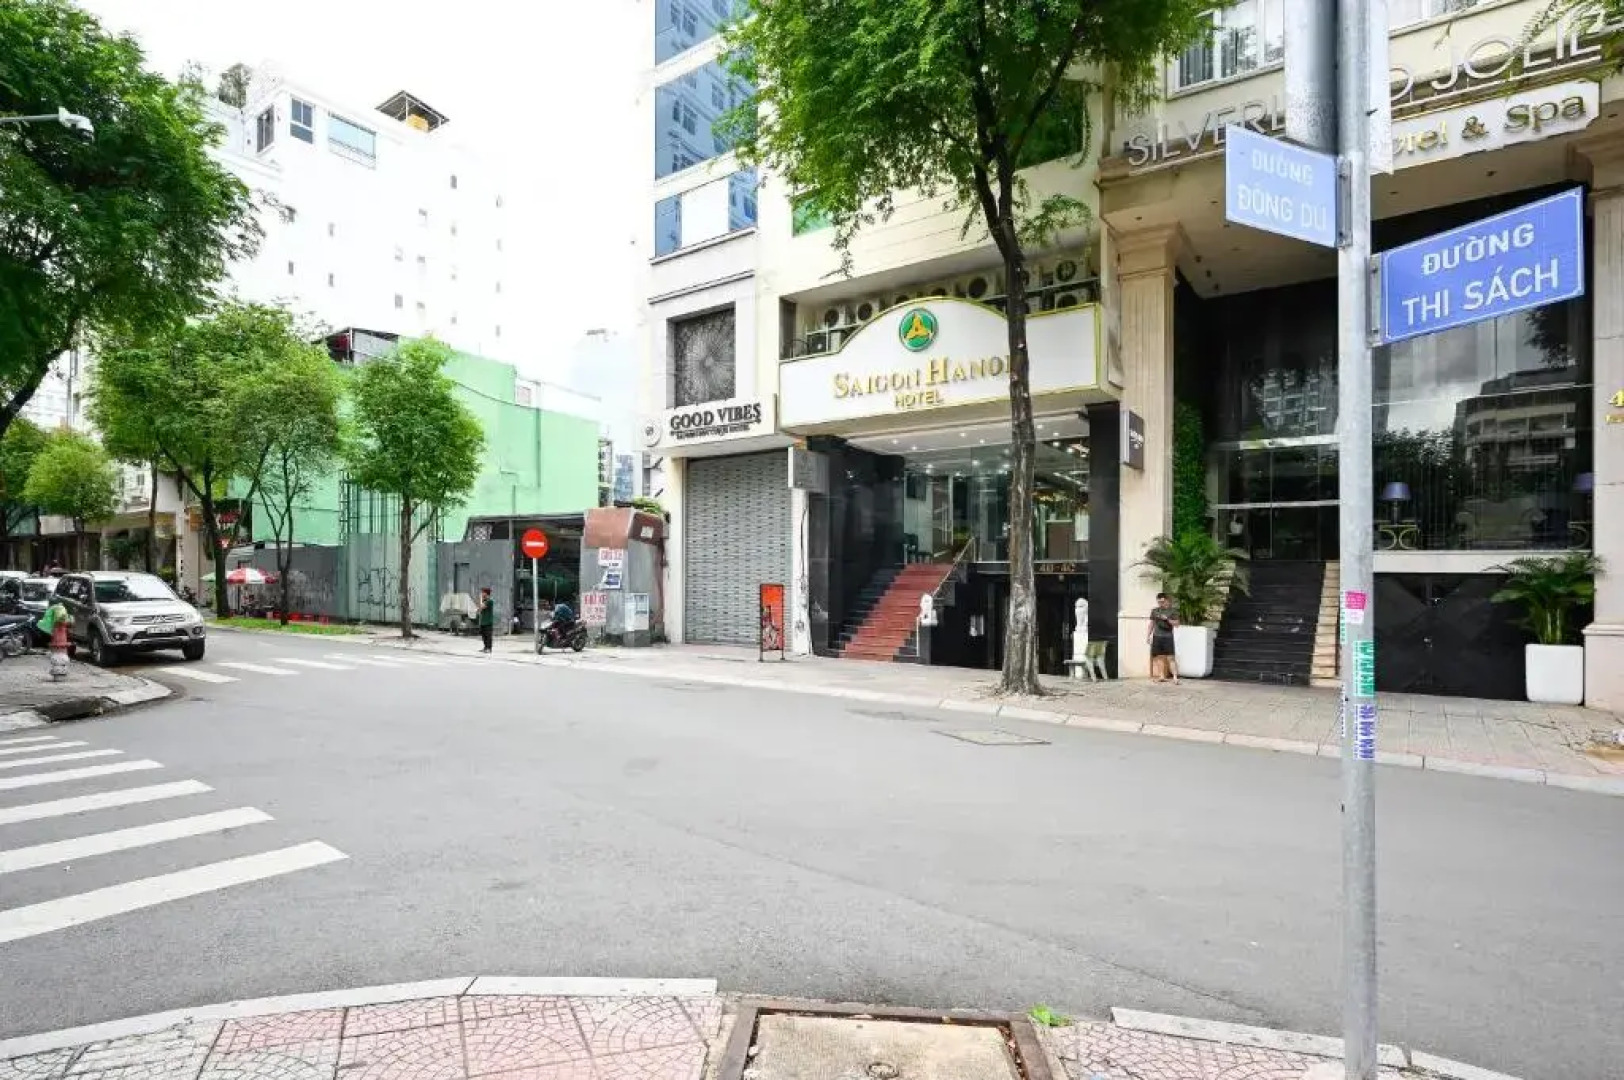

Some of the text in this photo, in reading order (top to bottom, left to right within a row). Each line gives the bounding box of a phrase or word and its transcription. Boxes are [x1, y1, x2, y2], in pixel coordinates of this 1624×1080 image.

[1430, 8, 1602, 90] JOLIE
[1392, 95, 1587, 156] otel & Spa
[1301, 203, 1327, 232] DU
[1421, 223, 1535, 275] ĐƯỜNG
[1402, 265, 1559, 325] THI SÁCH
[833, 354, 1010, 399] SAIGON HANOI
[895, 389, 944, 408] HOTEL
[670, 402, 761, 430] GOOD VIBES
